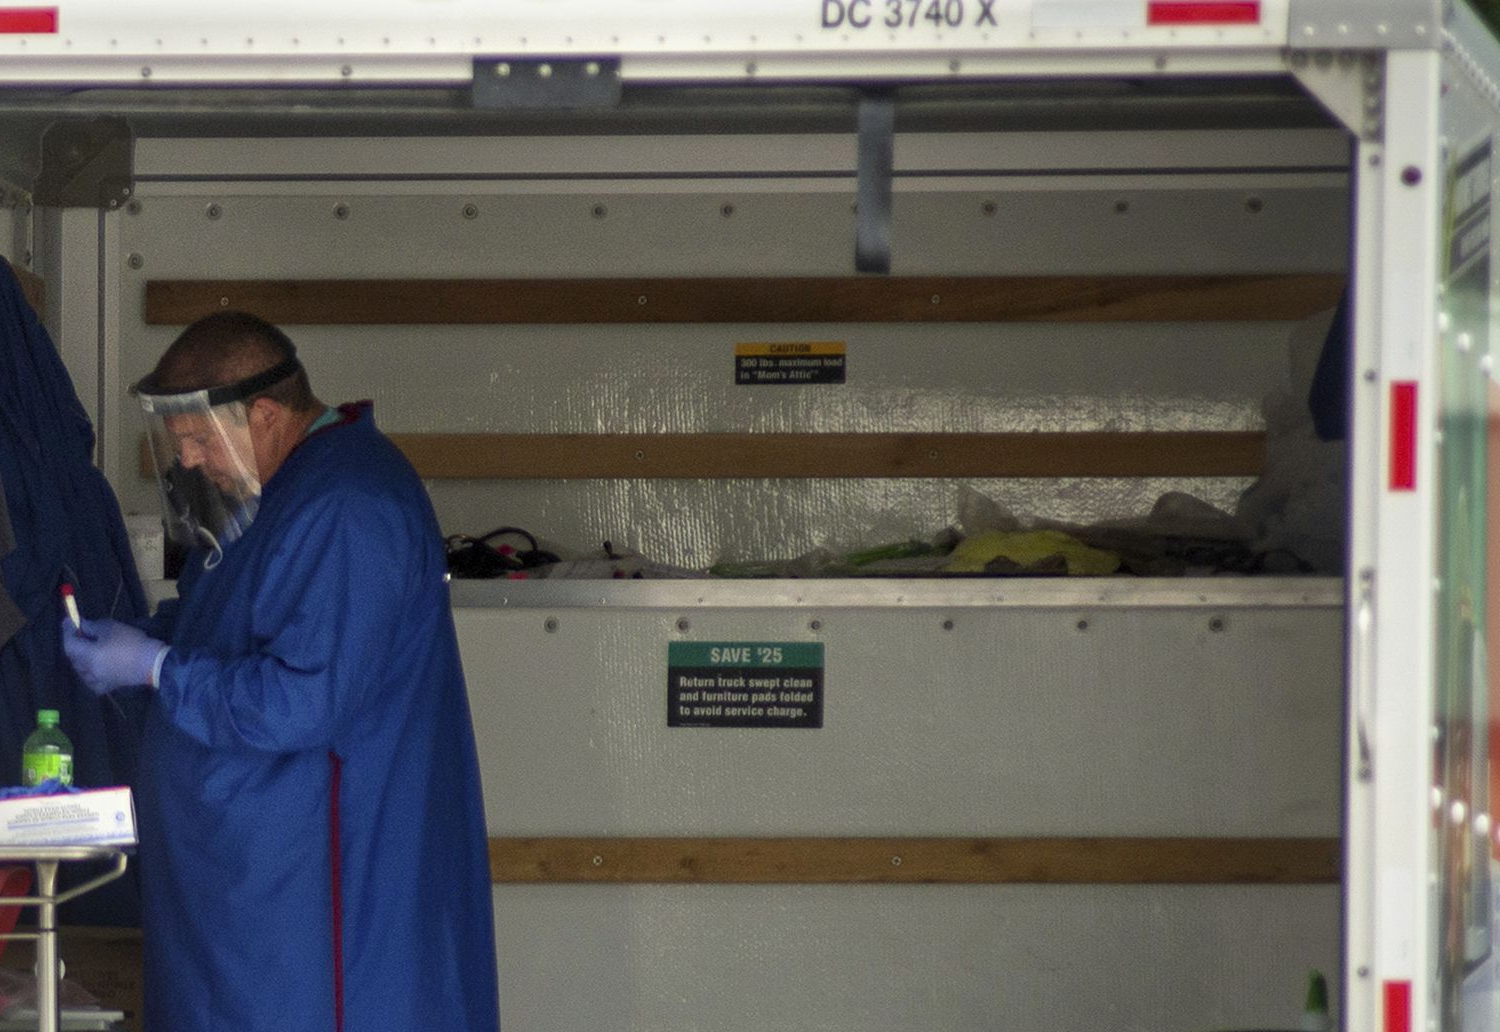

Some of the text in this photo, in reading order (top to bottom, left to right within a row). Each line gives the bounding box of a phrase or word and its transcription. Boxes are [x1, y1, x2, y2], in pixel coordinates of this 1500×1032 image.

[821, 0, 998, 28] DC 3740 X
[769, 344, 811, 353] CAUTION
[779, 358, 822, 368] maximum
[823, 357, 843, 367] load
[740, 370, 750, 380] in
[710, 647, 751, 663] SAVE
[679, 676, 813, 690] Return truck swept clean
[679, 691, 814, 705] and furniture pads folded
[679, 705, 808, 718] to avoid service charge.
